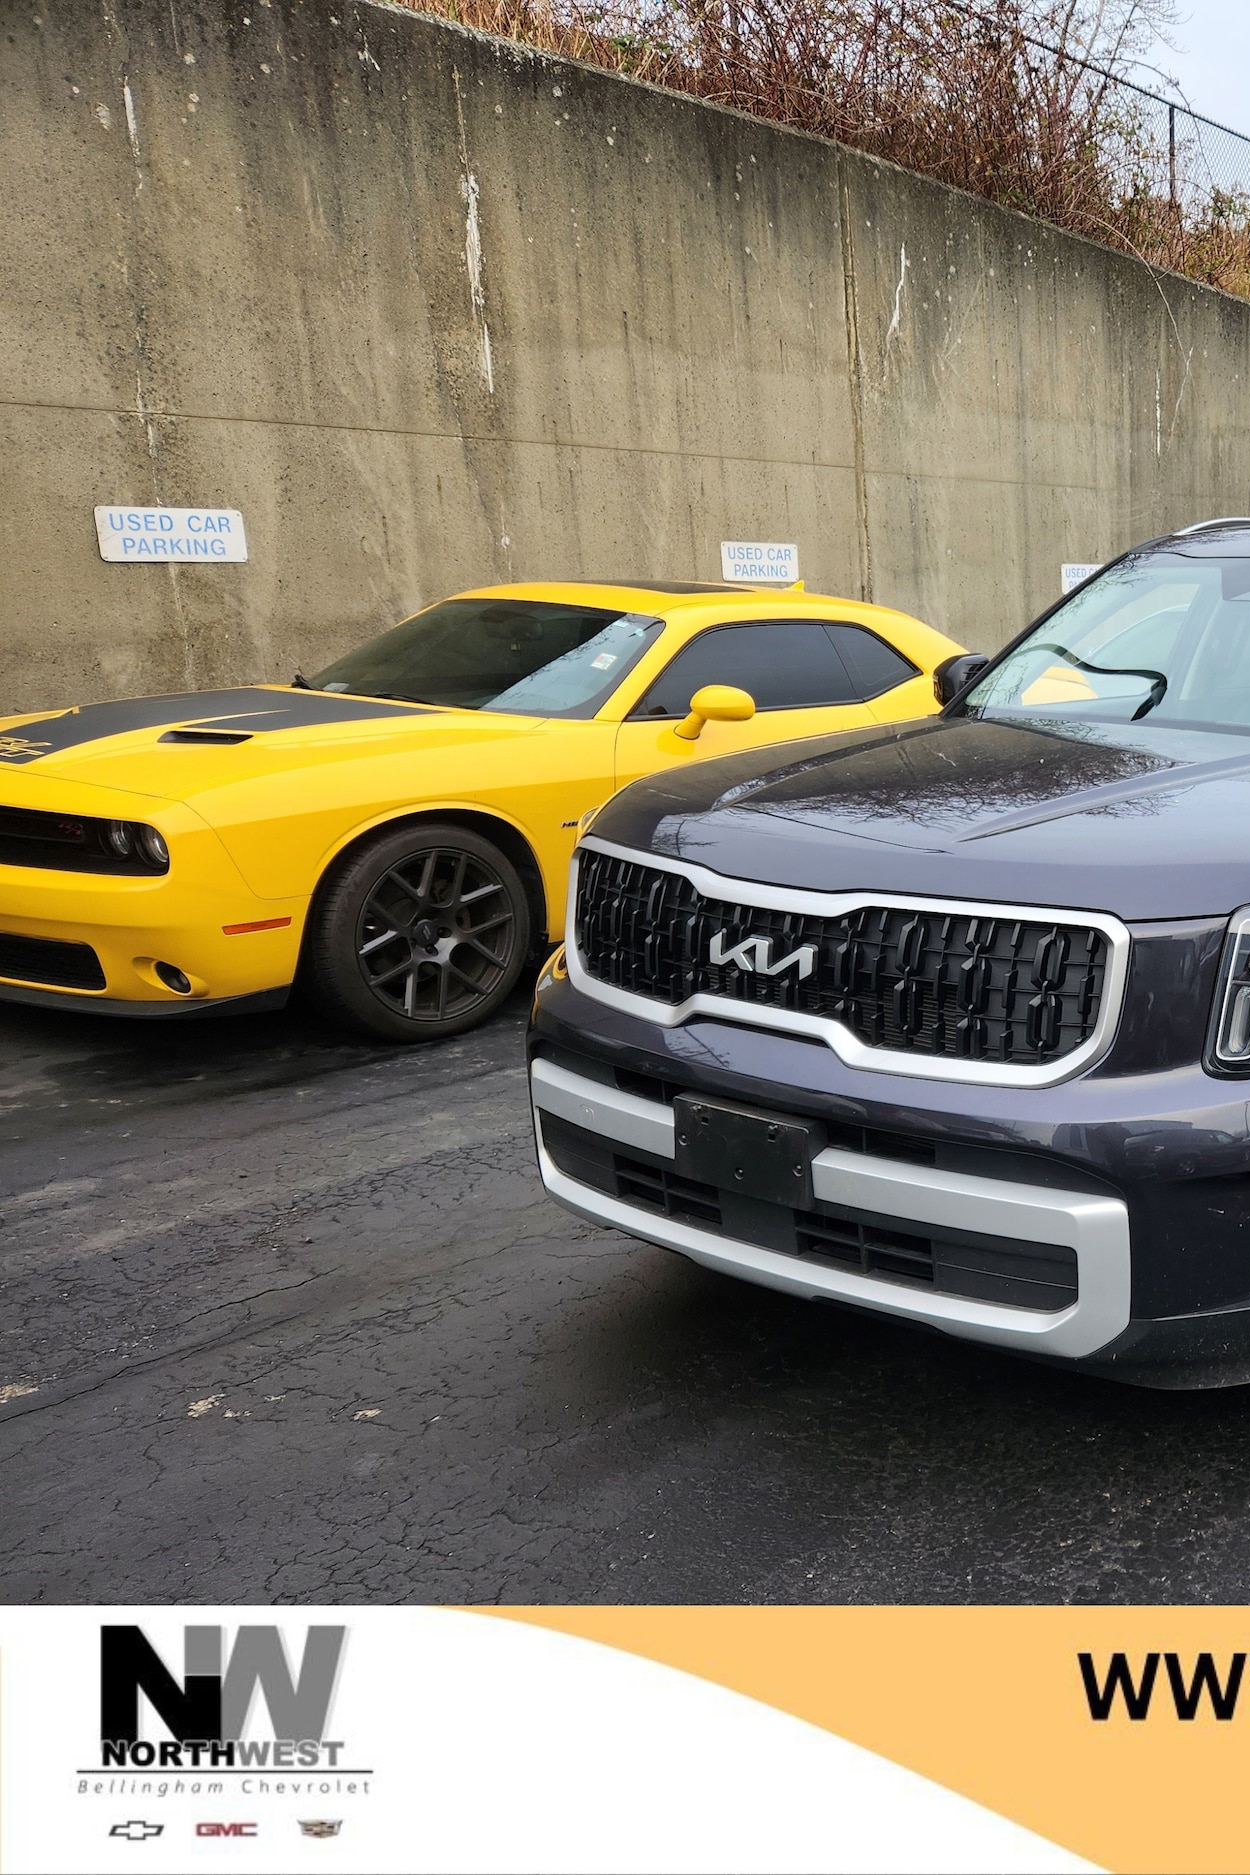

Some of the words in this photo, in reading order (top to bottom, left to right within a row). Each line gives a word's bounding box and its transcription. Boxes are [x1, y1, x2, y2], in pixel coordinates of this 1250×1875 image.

[109, 513, 174, 532] USED
[187, 515, 232, 533] CAR
[123, 538, 226, 556] PARKING
[728, 547, 763, 560] USED
[767, 548, 792, 561] CAR
[734, 564, 788, 577] PARKING
[1065, 568, 1086, 578] USED
